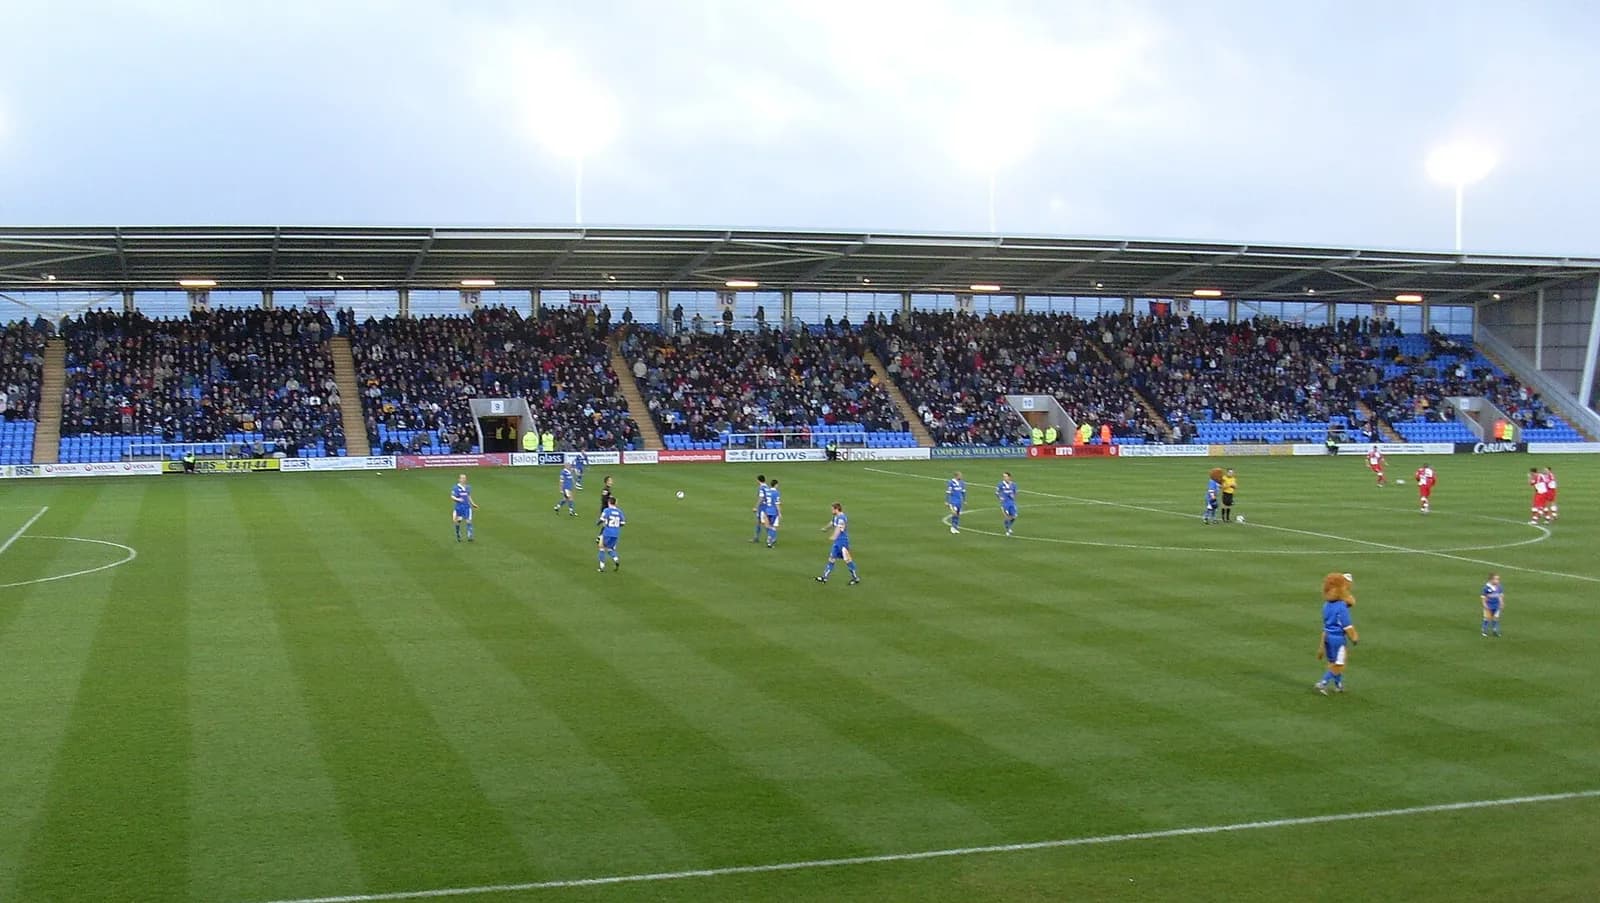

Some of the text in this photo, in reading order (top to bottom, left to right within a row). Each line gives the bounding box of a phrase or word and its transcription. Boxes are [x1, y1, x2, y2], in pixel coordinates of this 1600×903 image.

[463, 293, 478, 304] 15
[719, 293, 733, 305] 16
[973, 447, 1011, 455] WILLIAMS
[1474, 442, 1517, 453] CARLING
[750, 450, 807, 460] furrows
[609, 516, 621, 527] 20
